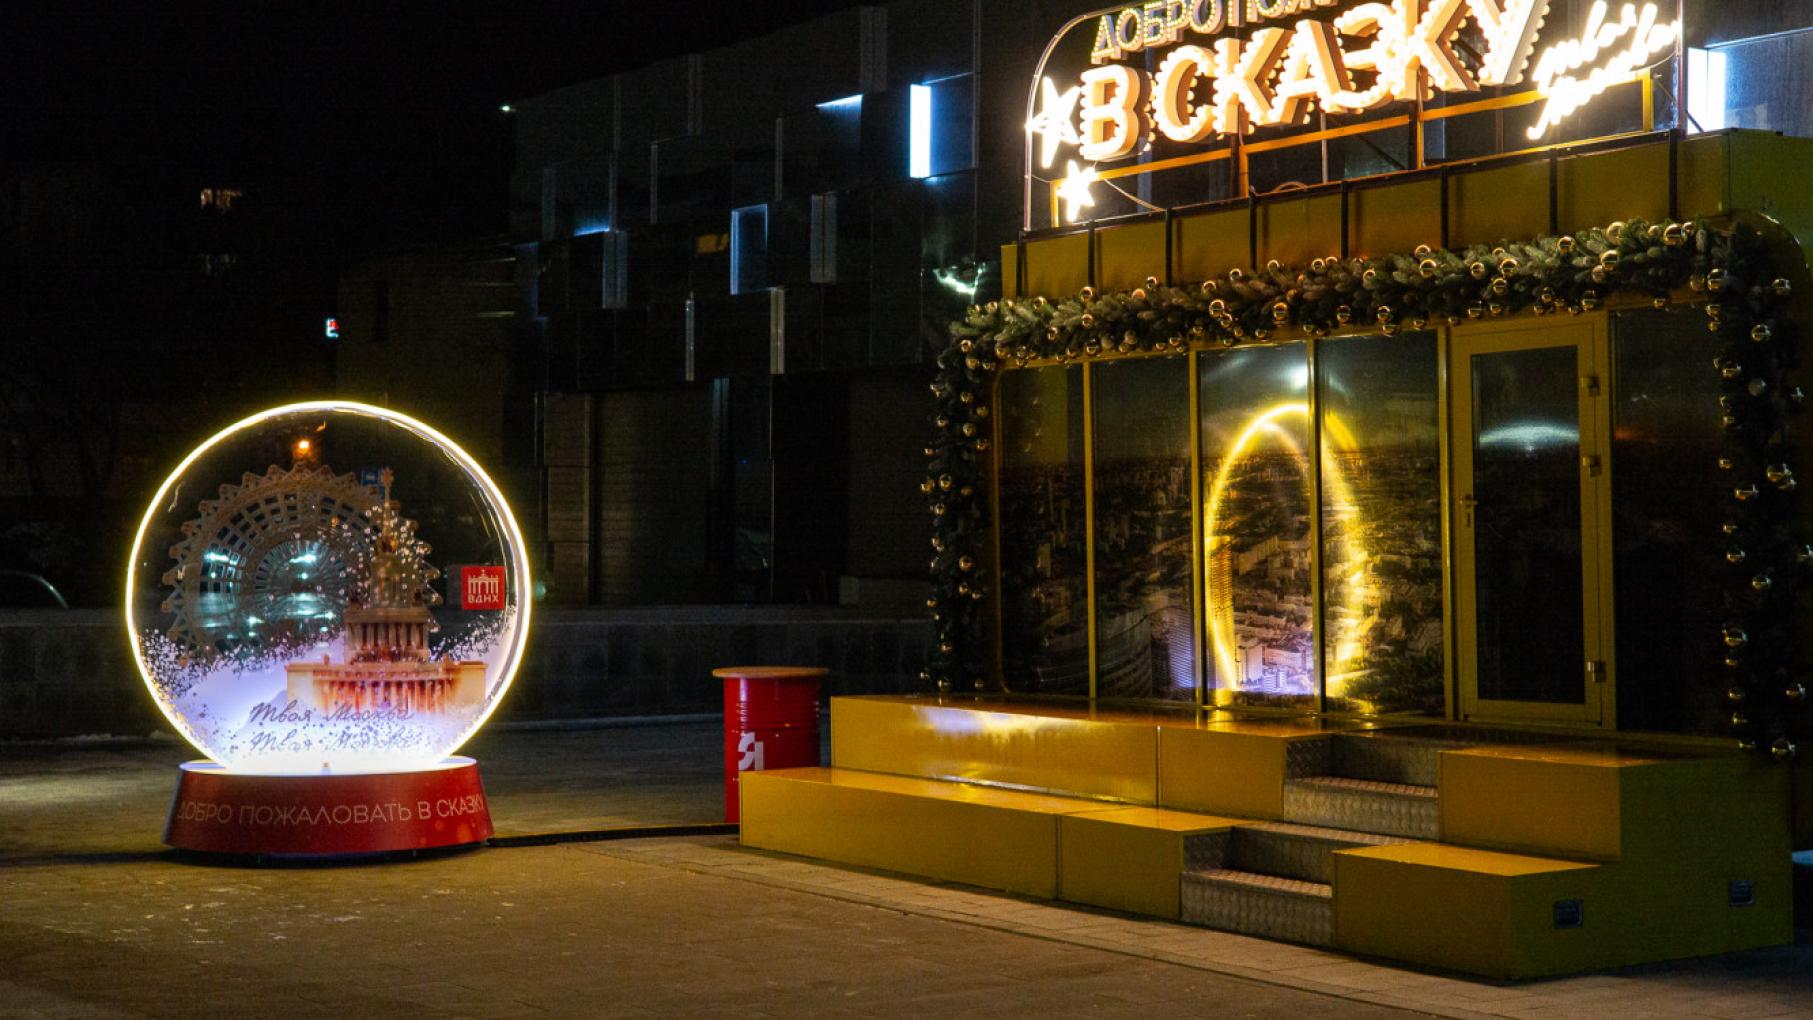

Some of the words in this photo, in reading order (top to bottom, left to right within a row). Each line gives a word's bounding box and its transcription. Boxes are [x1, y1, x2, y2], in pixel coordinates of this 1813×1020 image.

[1091, 0, 1225, 64] ДОБРО
[1080, 64, 1152, 162] В
[1154, 0, 1550, 142] СКАЗКУ
[467, 594, 499, 604] ВДНХ
[239, 801, 412, 825] ПОЖАЛОВАТЬ
[417, 800, 431, 820] В
